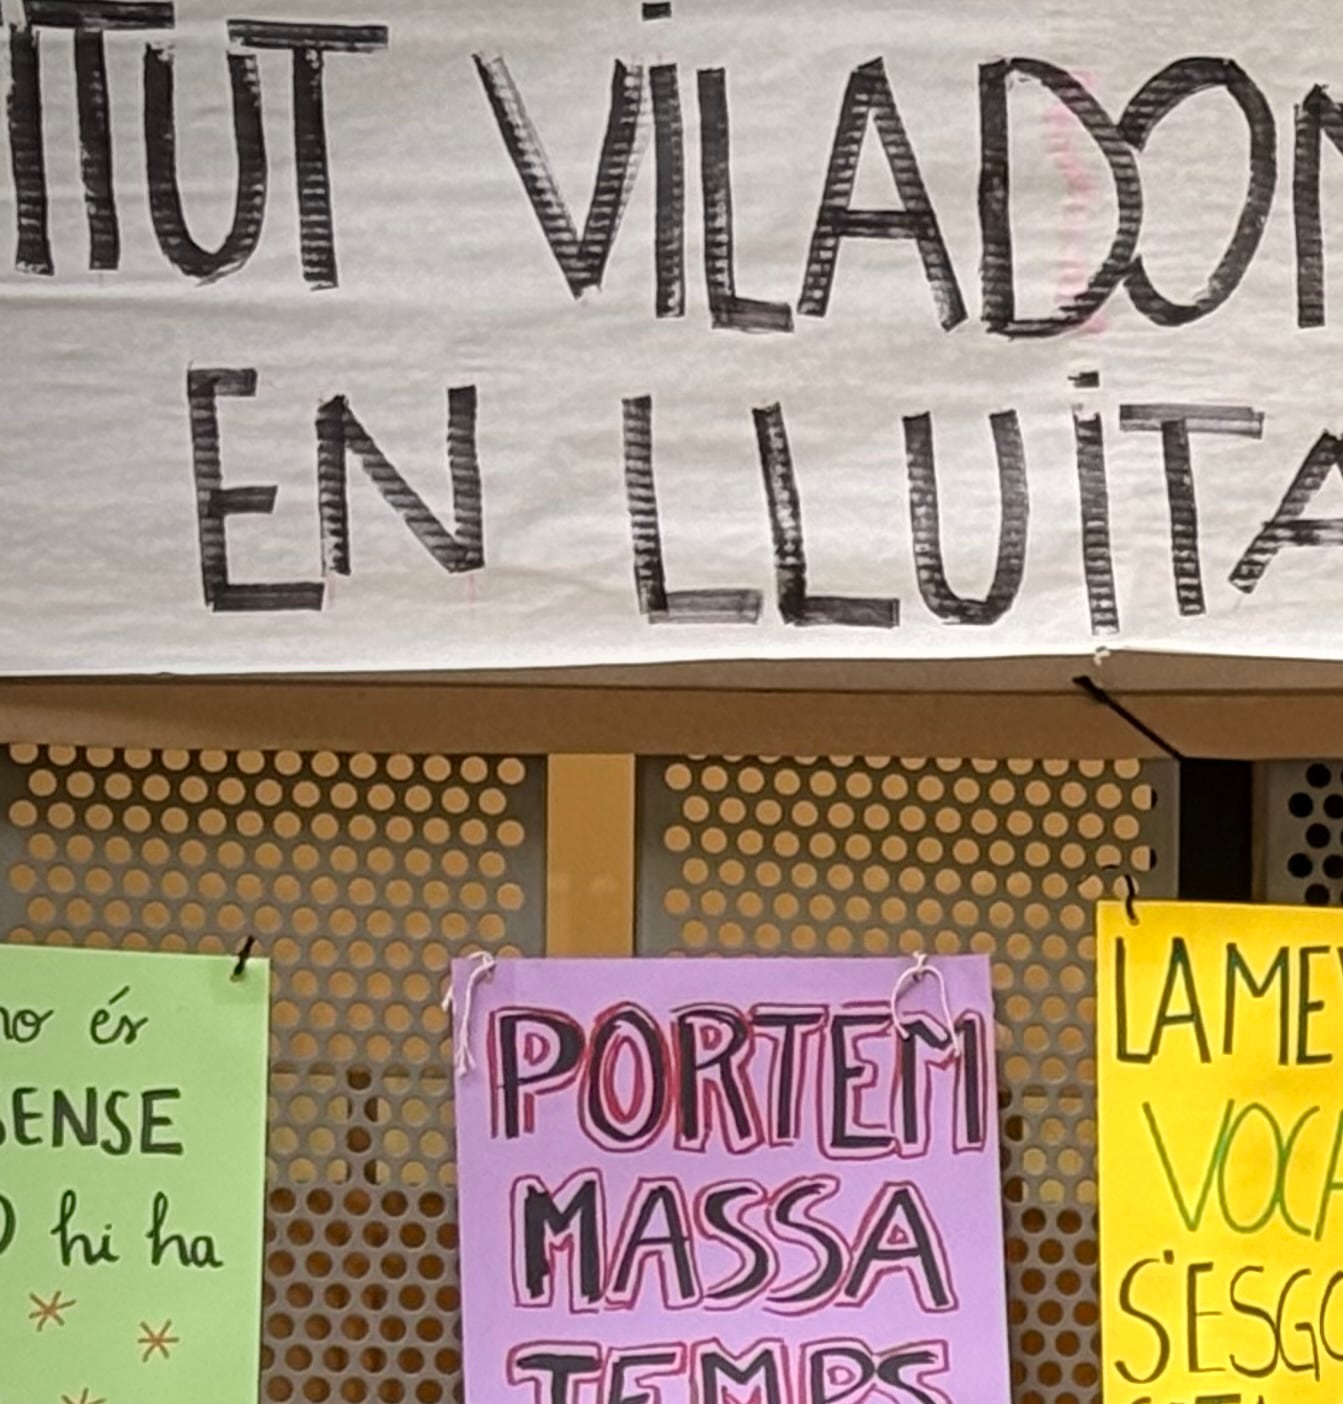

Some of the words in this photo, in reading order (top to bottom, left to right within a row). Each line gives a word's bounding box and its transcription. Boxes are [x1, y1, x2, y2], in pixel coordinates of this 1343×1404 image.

[187, 362, 485, 612] EN
[90, 985, 149, 1045] és
[487, 1002, 989, 1158] PORTEM
[50, 1189, 120, 1267] hi
[146, 1191, 223, 1268] ha
[511, 1169, 958, 1314] MASSA
